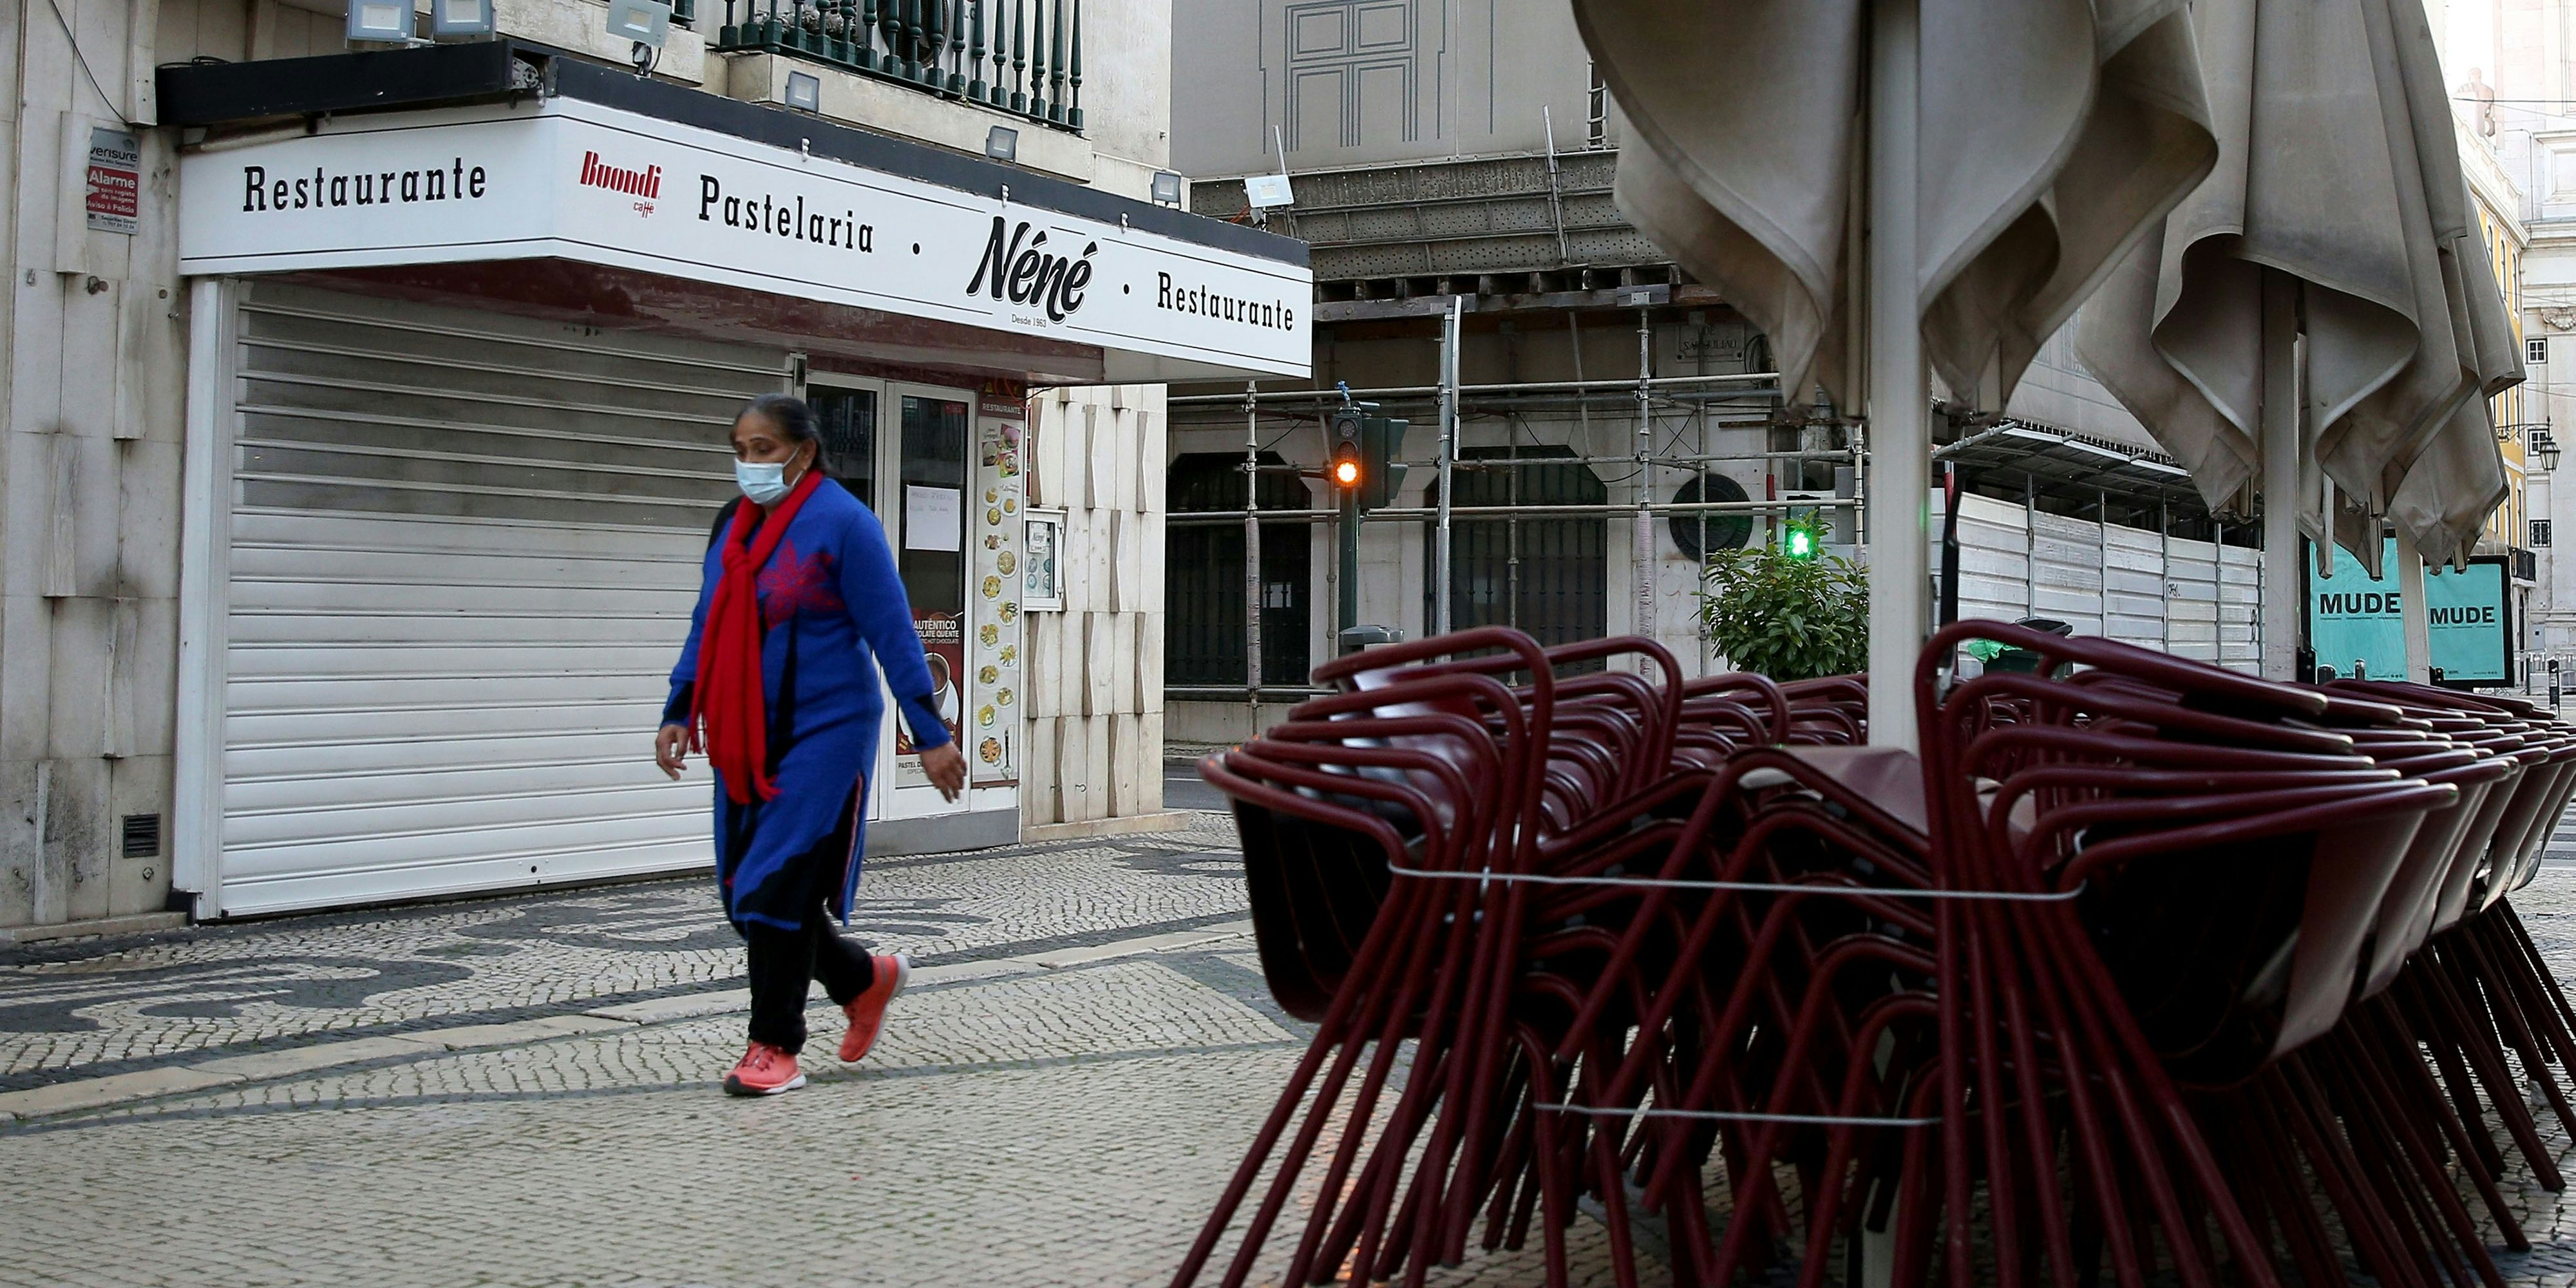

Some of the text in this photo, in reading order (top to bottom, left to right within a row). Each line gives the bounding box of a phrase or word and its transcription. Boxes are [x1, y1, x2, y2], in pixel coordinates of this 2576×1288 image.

[91, 147, 137, 162] verisure
[89, 170, 136, 189] Alarme
[243, 158, 486, 212] Restaurante
[580, 151, 661, 199] Buondi
[88, 200, 106, 209] Aviso
[699, 175, 873, 252] Pastelaria
[966, 216, 1098, 324] Néné
[1157, 271, 1293, 331] Restaurante
[1012, 314, 1046, 328] Desde 1963
[982, 403, 1021, 415] RESTAURANTE
[2320, 593, 2400, 614] MUDE
[2430, 607, 2495, 625] MUDE
